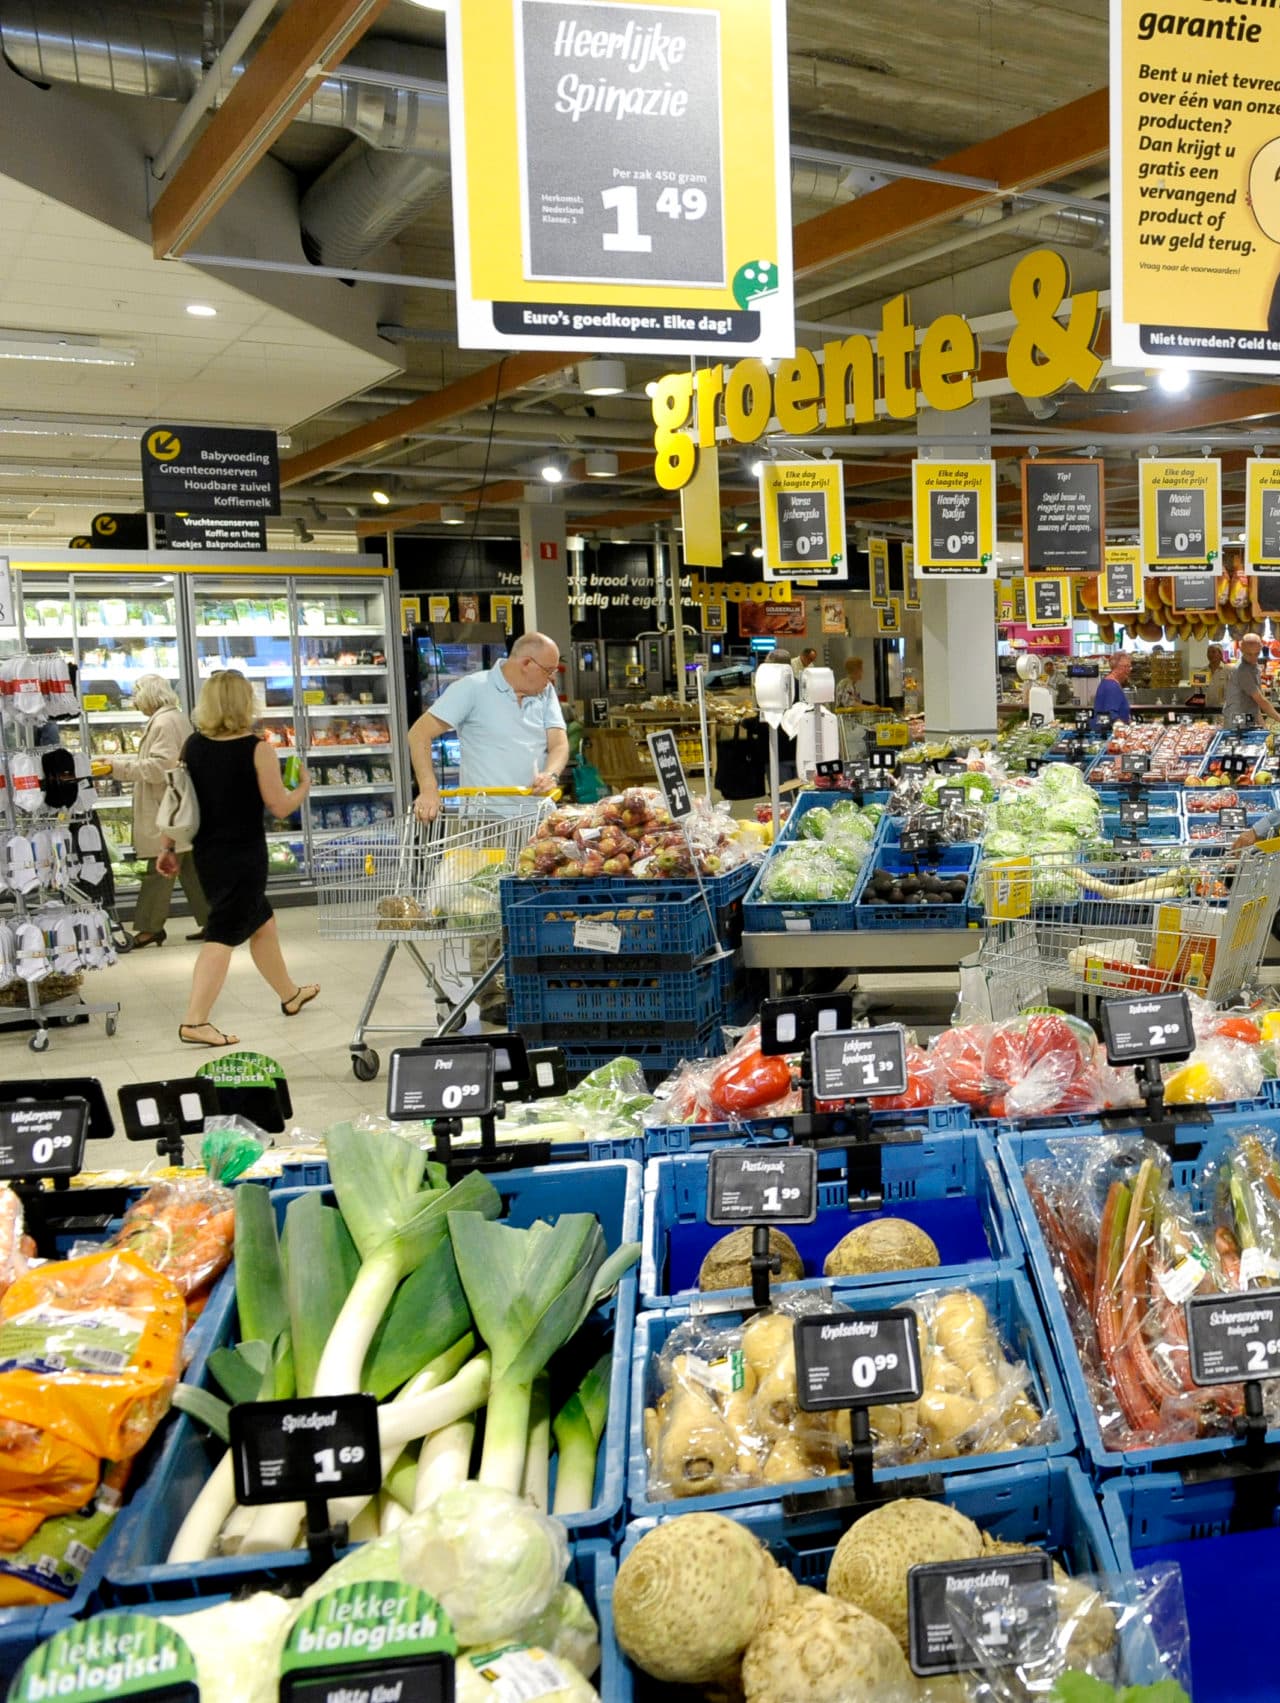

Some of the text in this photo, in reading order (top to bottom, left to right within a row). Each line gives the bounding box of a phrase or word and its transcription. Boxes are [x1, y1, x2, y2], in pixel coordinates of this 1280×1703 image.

[1137, 11, 1262, 43] garantie
[554, 20, 686, 73] Heerlijke
[1139, 64, 1177, 82] Bent
[1181, 71, 1192, 83] u
[1196, 69, 1229, 87] niet
[555, 73, 688, 122] Spinazie
[1139, 92, 1174, 106] over
[1179, 91, 1208, 109] één
[1213, 98, 1242, 112] van
[1138, 114, 1232, 134] producten?
[1139, 135, 1236, 161] Dan krijgt u
[613, 168, 707, 184] Per zak 450 gram
[1138, 161, 1219, 180] gratis een
[1139, 184, 1236, 207] vervangend
[1138, 209, 1226, 231] product of
[1139, 232, 1256, 256] uw geld terug.
[573, 313, 660, 331] goedkoper.
[663, 316, 696, 329] Elke
[699, 317, 733, 332] dag!
[1150, 332, 1175, 346] Niet
[1177, 335, 1236, 349] tevreden?
[1238, 336, 1264, 350] Geld
[652, 249, 1104, 491] groente &
[200, 450, 270, 465] Babyvoeding
[160, 464, 258, 477] Groenteconserven
[184, 480, 271, 492] Houdbare zuivel
[214, 497, 271, 507] Koffiemelk
[327, 1596, 408, 1623] lekker
[298, 1618, 438, 1653] biologisch
[60, 1630, 146, 1667] lekker
[29, 1651, 177, 1700] biologisch
